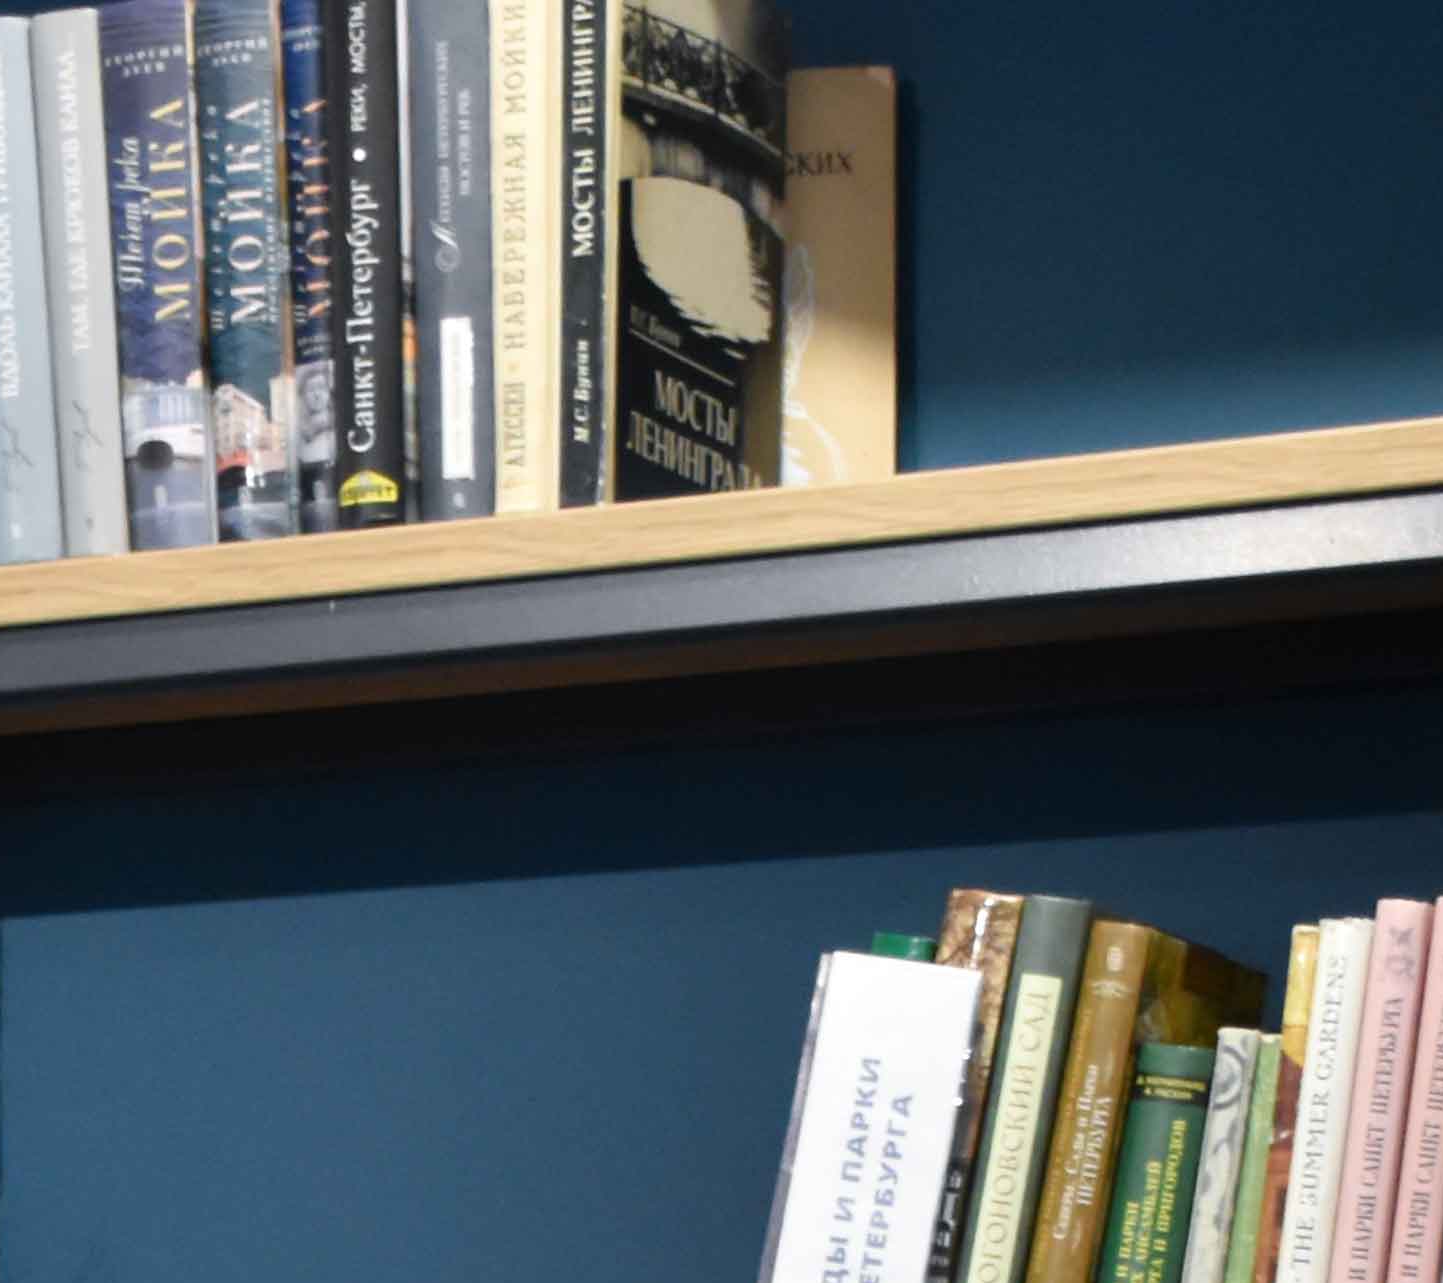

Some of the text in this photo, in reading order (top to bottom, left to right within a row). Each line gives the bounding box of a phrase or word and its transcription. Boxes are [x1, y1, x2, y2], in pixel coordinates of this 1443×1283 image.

[149, 97, 190, 323] МОЙКА
[223, 99, 266, 323] МОЙКА
[346, 1, 379, 452] Санкт-Петербург РЕКИ, МОСТЫ,
[497, 0, 526, 350] НАБЕРЕЖНАЯ МОЙКИ
[654, 369, 736, 447] МОСТЫ
[1314, 956, 1348, 1081] GARDENS
[841, 1057, 881, 1183] ПАРКИ
[1295, 1091, 1328, 1206] SUMMER
[831, 1196, 853, 1220] И
[1289, 1217, 1314, 1269] THE
